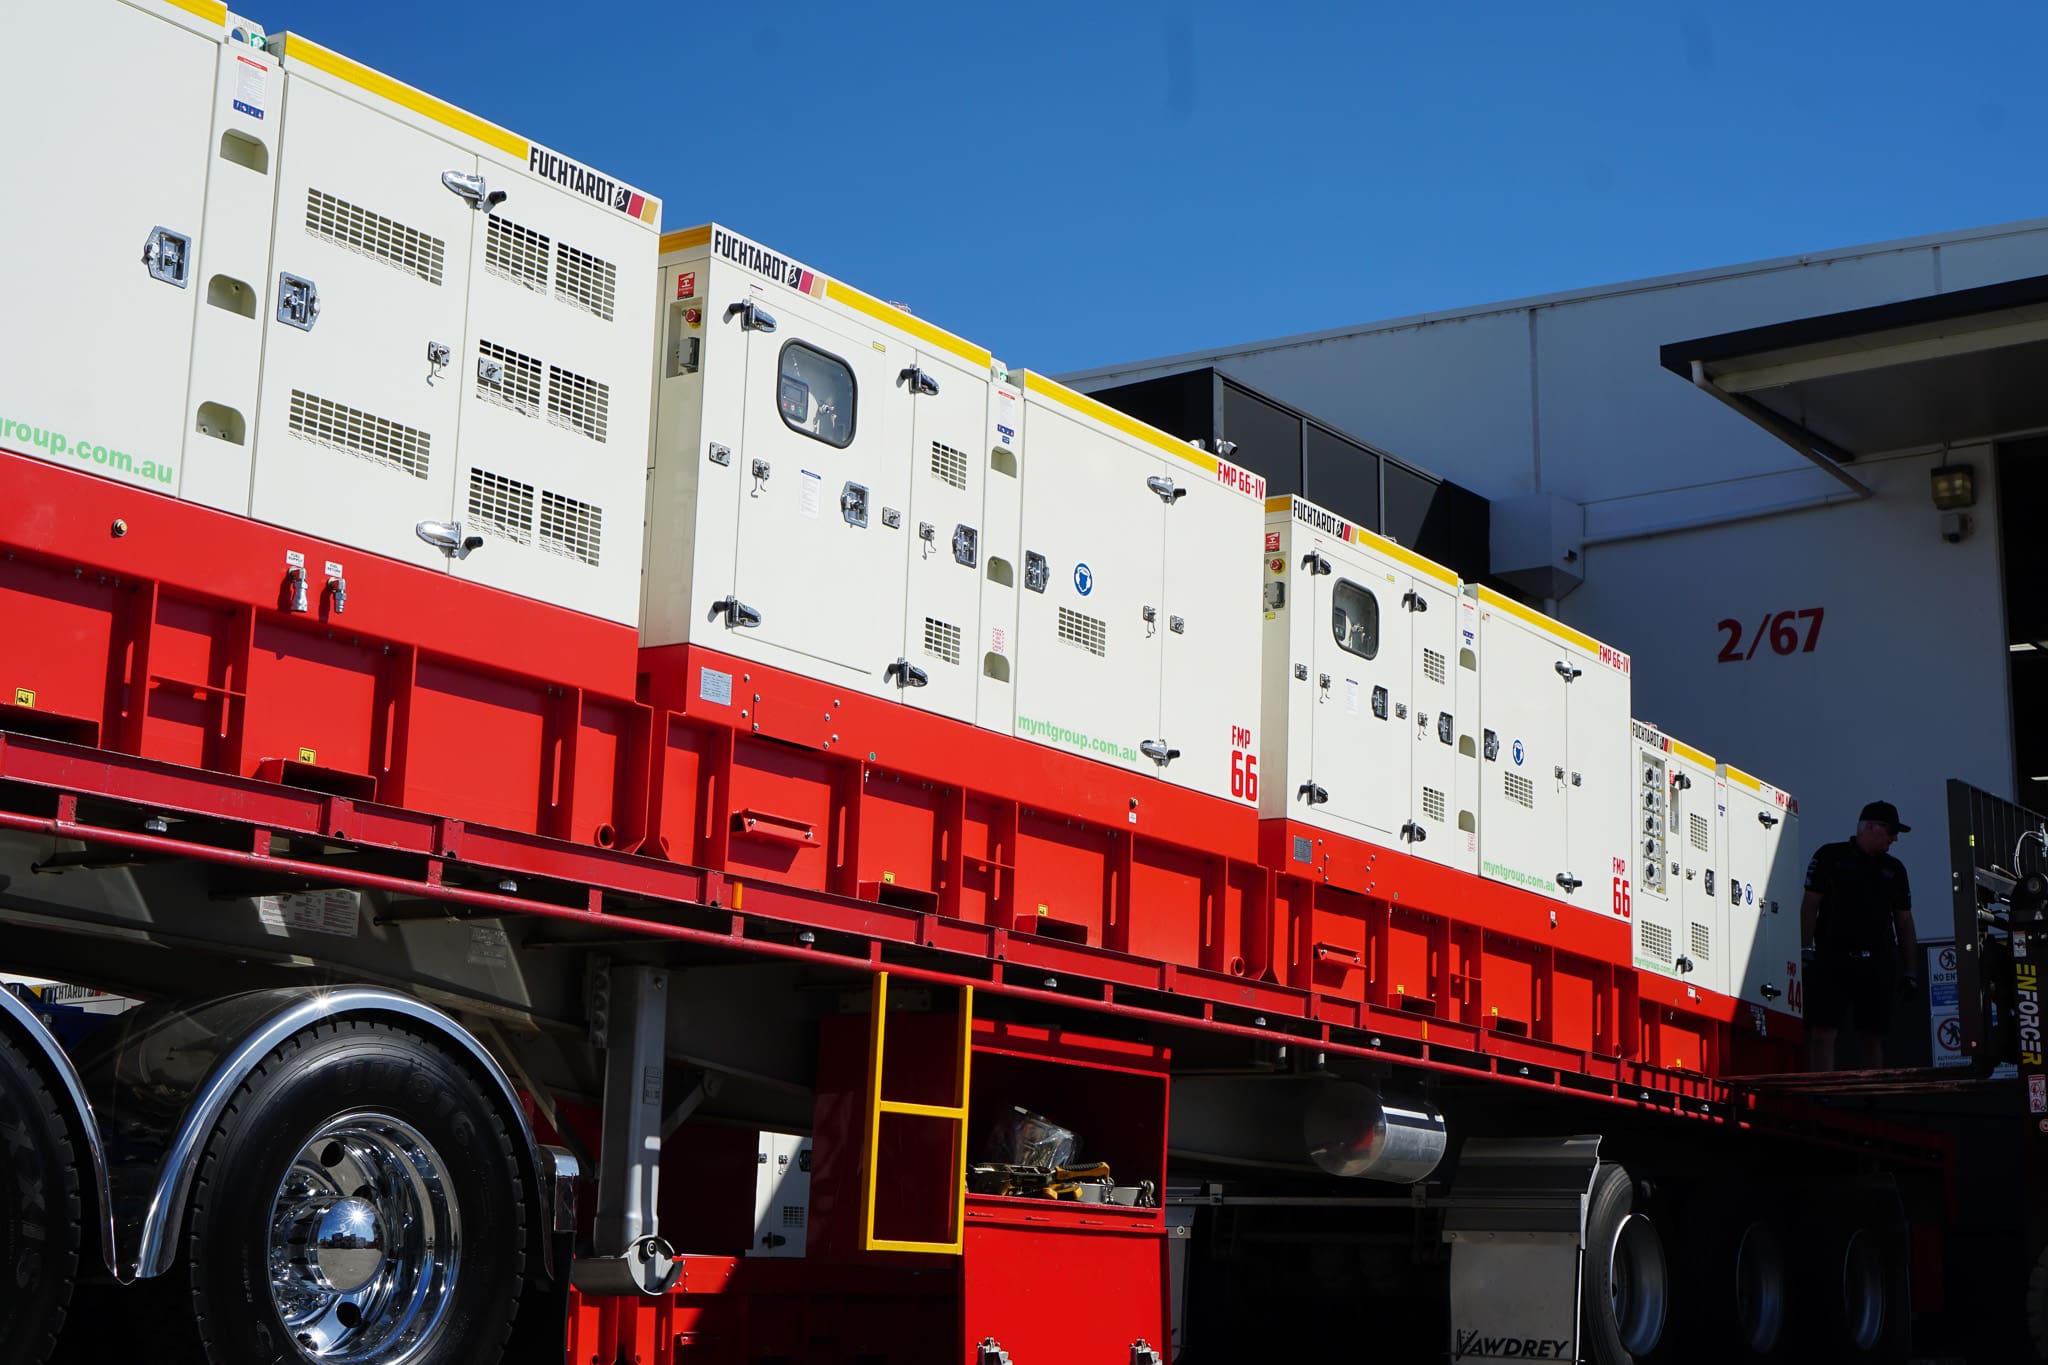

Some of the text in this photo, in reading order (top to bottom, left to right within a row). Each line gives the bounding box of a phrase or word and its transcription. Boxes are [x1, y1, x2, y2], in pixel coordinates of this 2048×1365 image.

[529, 146, 615, 207] FUCHTARDT
[714, 230, 788, 284] FUCHTARDT
[1217, 462, 1265, 501] FMP 66-IV
[1293, 499, 1337, 536] FUCHTARDT
[1717, 607, 1824, 663] 2/67
[1599, 645, 1612, 665] FMP
[1017, 716, 1137, 762] myntgroup.com.au
[1232, 725, 1251, 750] FMP
[1231, 750, 1257, 802] 66
[1483, 860, 1555, 893] myntgroup.com.au
[1612, 856, 1626, 876] FMP
[1613, 876, 1630, 918] 66
[1787, 978, 1802, 1014] 44
[2015, 963, 2043, 1066] ENFORCER
[1456, 1328, 1569, 1361] VAWDREY
